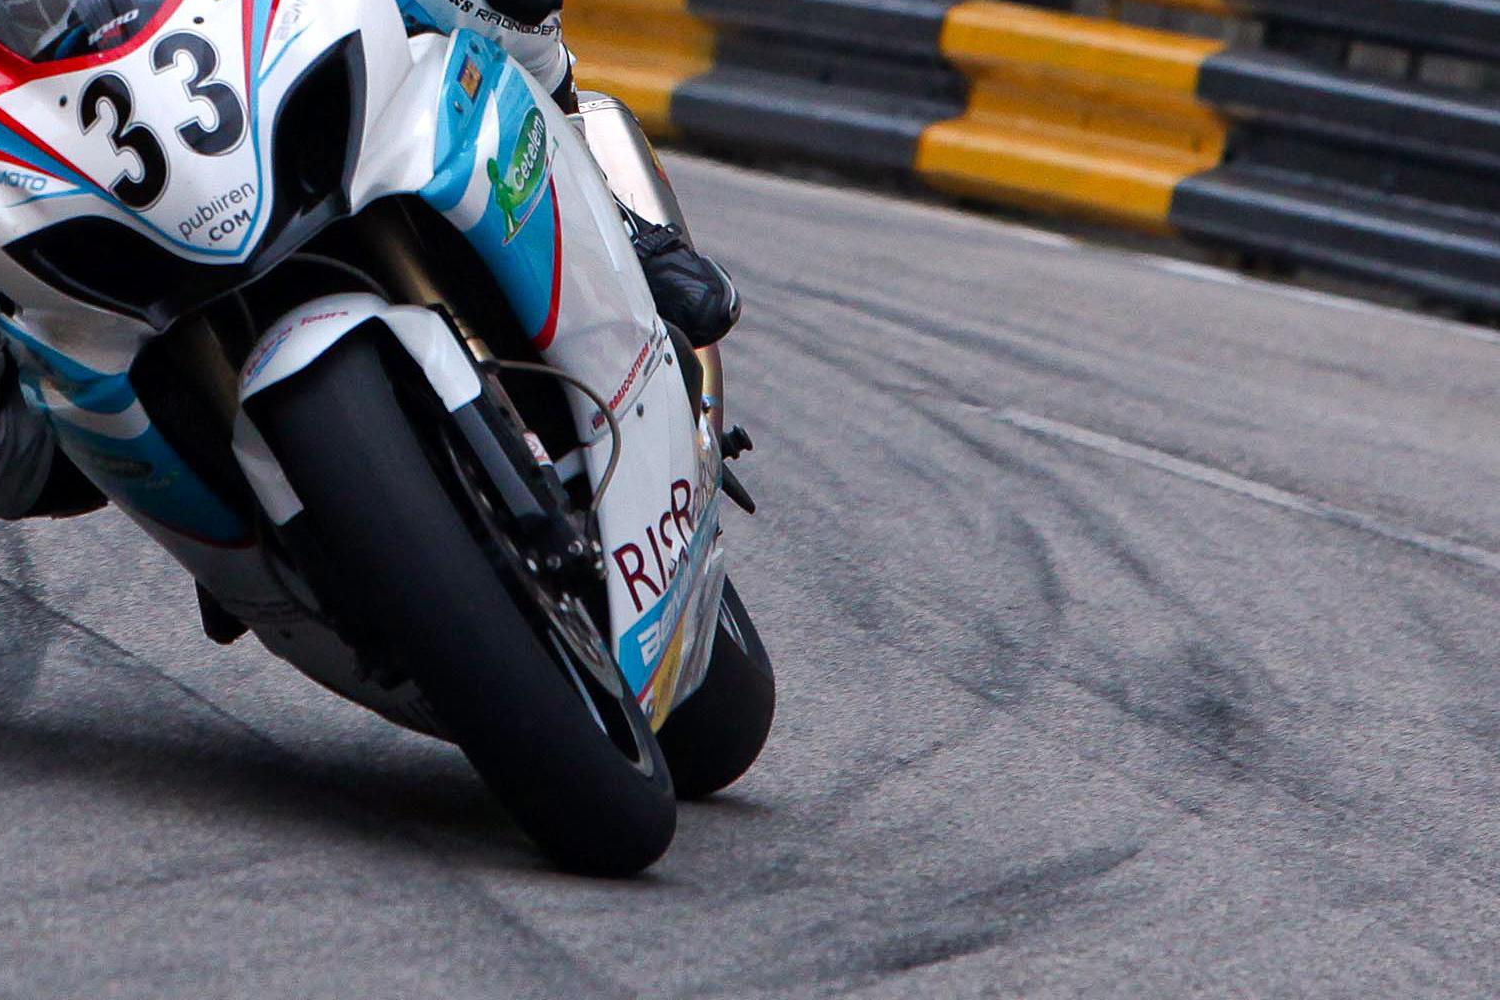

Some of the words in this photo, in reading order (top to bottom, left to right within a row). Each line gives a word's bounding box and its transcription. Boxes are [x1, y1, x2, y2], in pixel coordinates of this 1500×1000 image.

[78, 30, 248, 211] 33
[513, 115, 546, 192] Cetelem
[178, 182, 256, 241] publiren
